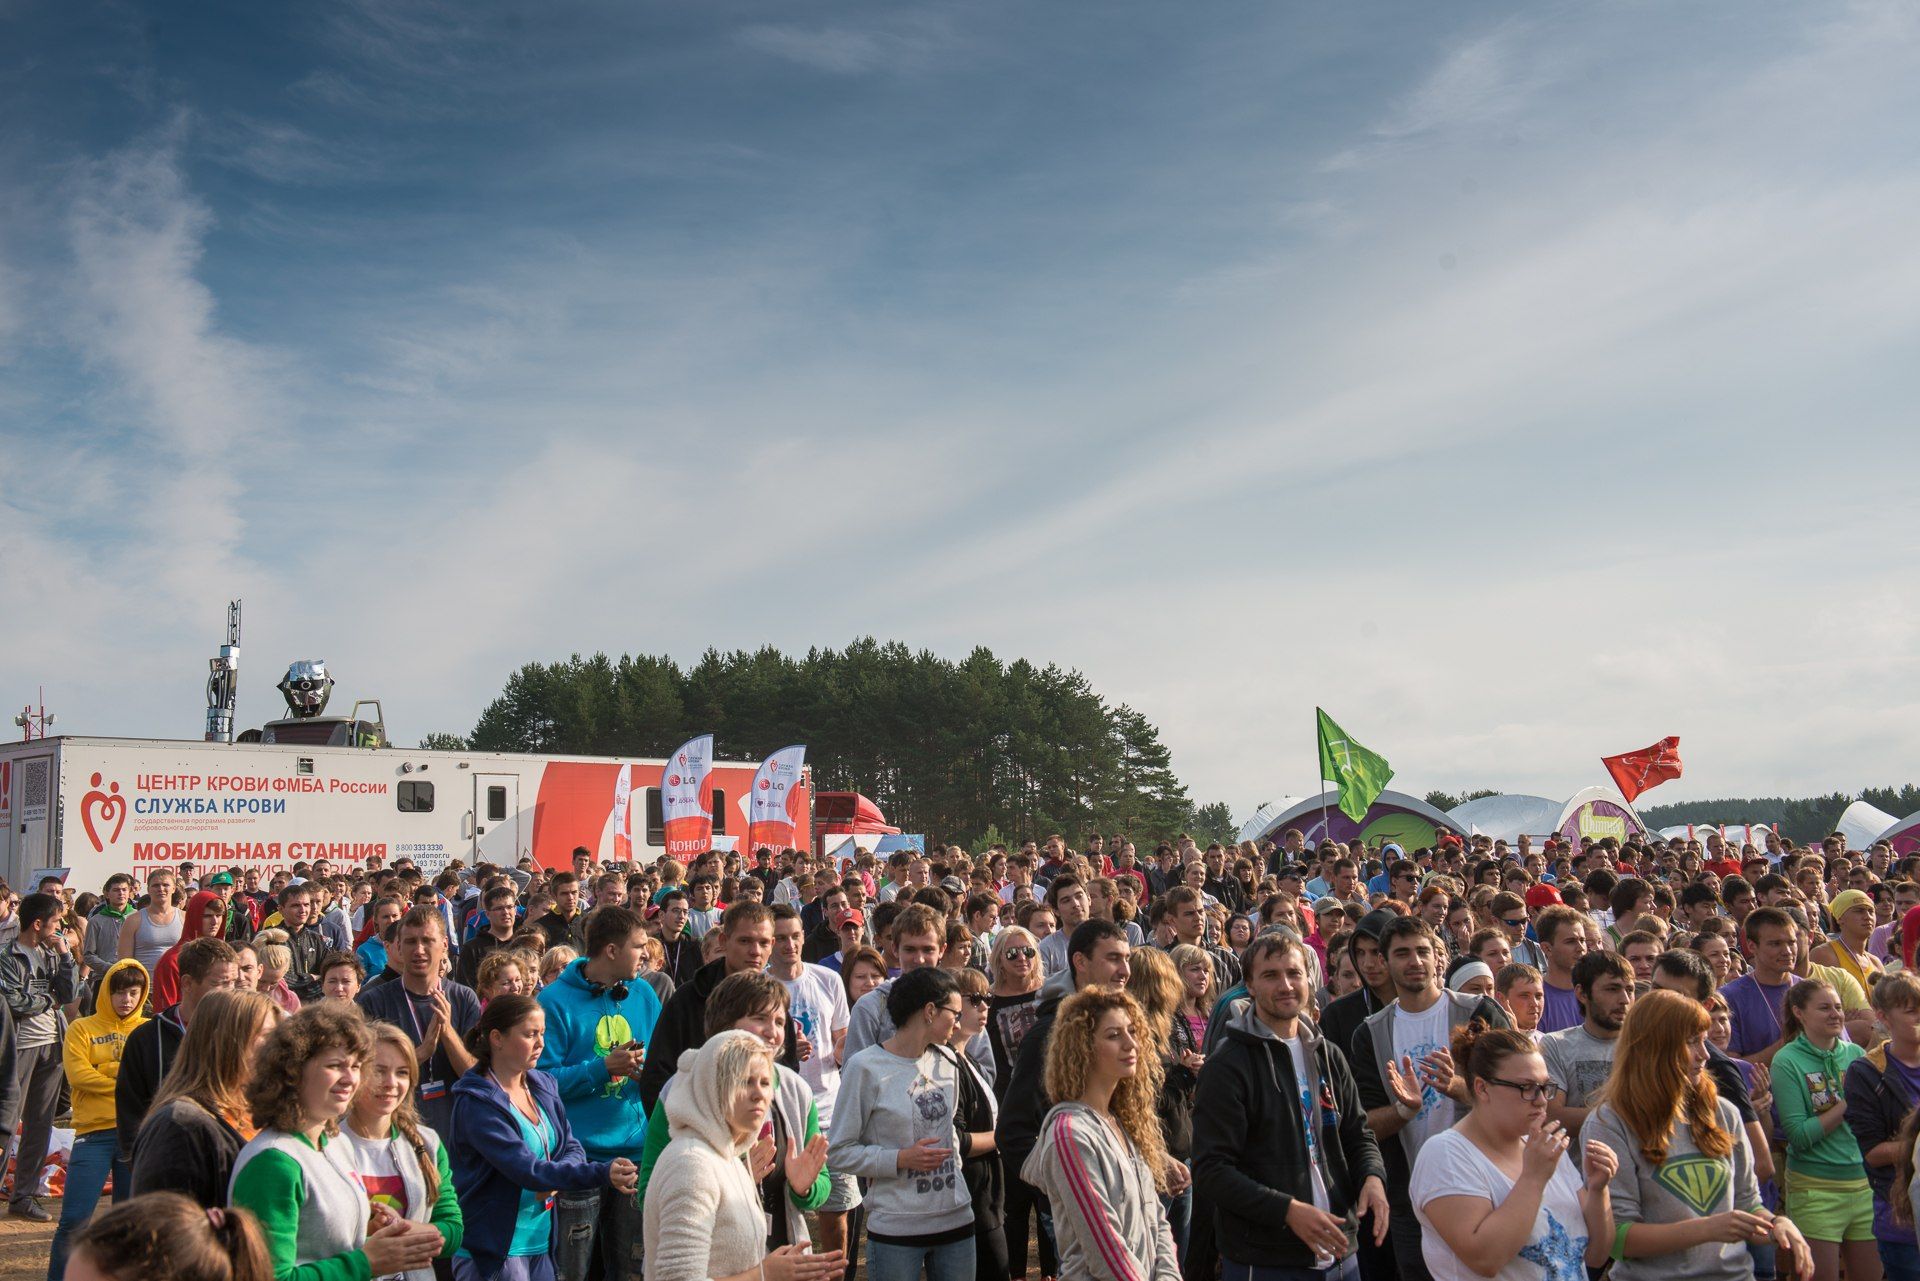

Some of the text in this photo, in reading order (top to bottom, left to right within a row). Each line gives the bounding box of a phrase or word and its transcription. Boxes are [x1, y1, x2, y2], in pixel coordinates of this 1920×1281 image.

[137, 774, 387, 794] ЦЕНТР КРОВИ ФМБА России
[683, 776, 696, 785] LG
[772, 782, 785, 791] LG
[134, 798, 286, 814] СЛУЖБА КРОВИ
[133, 842, 387, 863] МОБИЛЬНАЯ СТАНЦИЯ
[669, 839, 707, 852] ДОНОР
